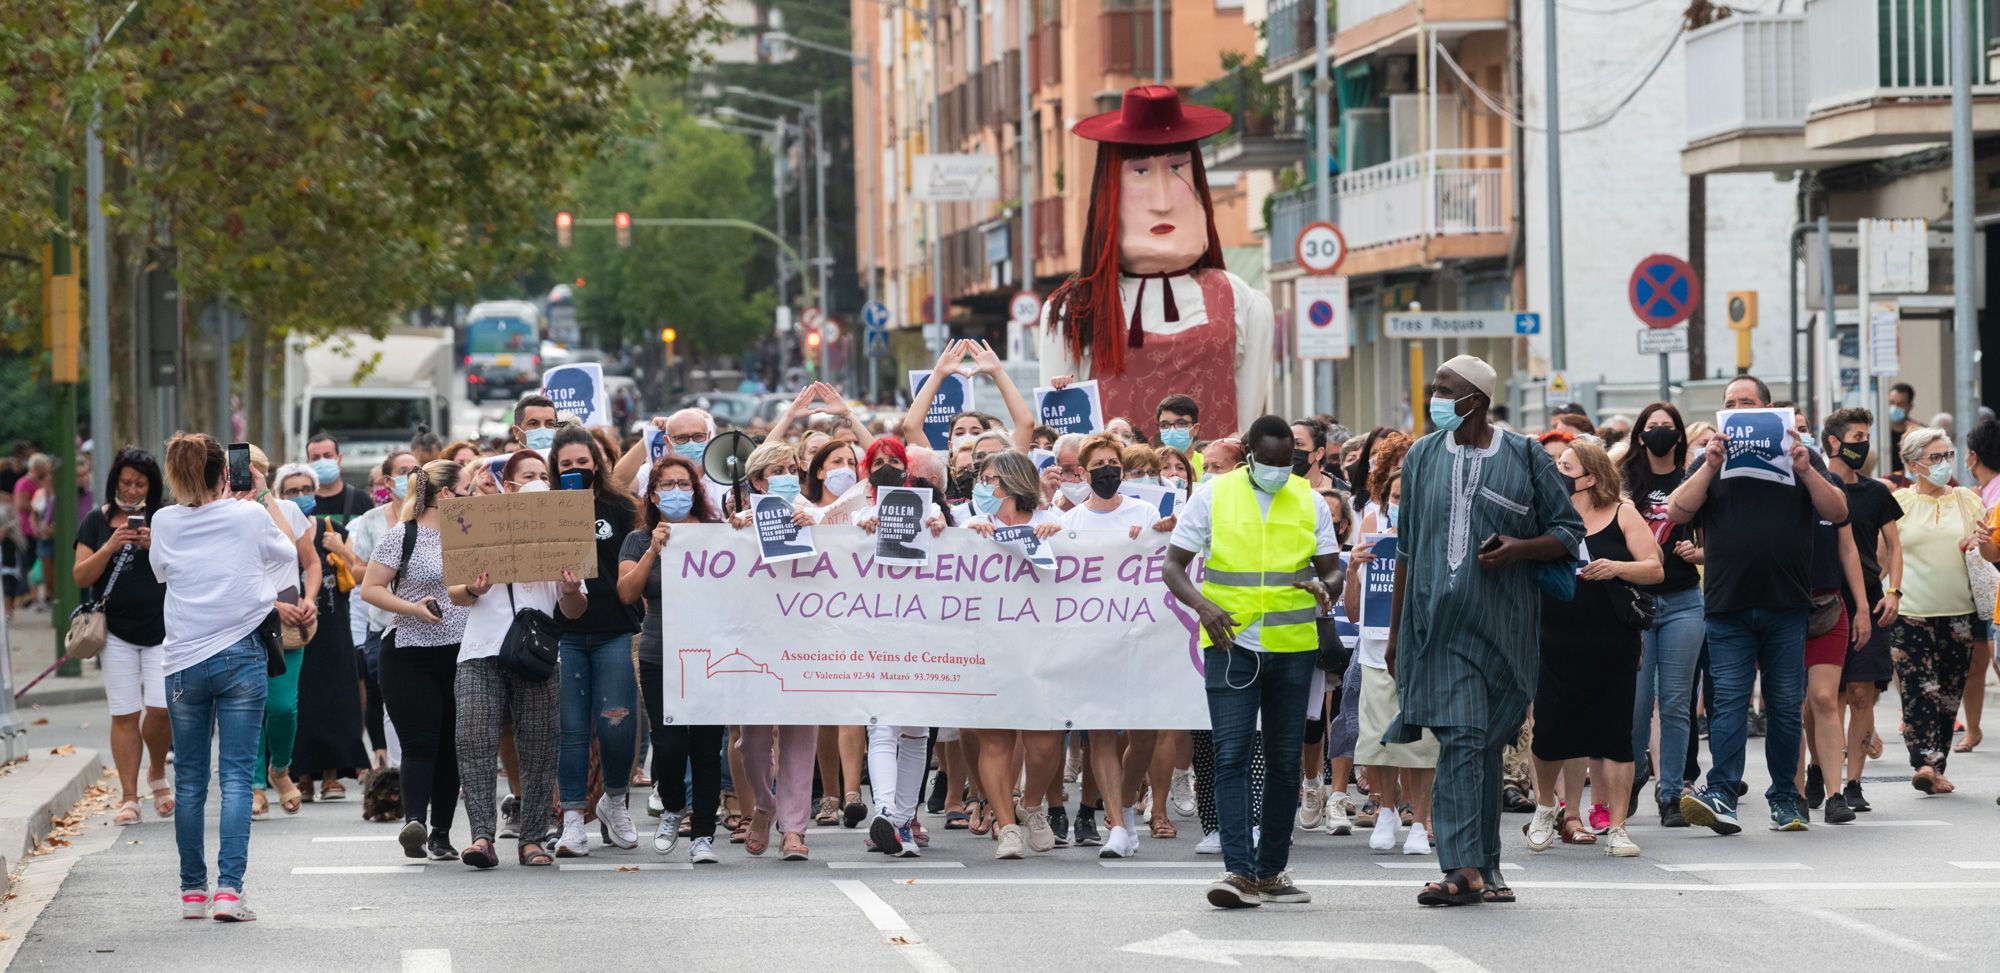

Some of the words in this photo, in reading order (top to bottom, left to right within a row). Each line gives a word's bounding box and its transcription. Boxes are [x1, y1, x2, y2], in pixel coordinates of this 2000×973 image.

[1305, 240, 1335, 257] 30
[1391, 318, 1423, 331] Tres
[1431, 317, 1485, 332] Roques
[546, 387, 576, 400] STOP
[554, 399, 586, 409] OLÈNCIA
[1042, 405, 1066, 418] CAP
[1045, 413, 1081, 426] AGRESSIÓ
[1725, 425, 1754, 438] CAP
[757, 508, 791, 520] VOLEM
[881, 505, 914, 516] VOLEM
[489, 519, 546, 533] TRABAJO
[995, 528, 1022, 541] STOP
[682, 550, 736, 578] NO
[748, 555, 776, 578] A
[791, 551, 838, 579] LA
[852, 551, 1041, 584] VIOLENCIA
[1055, 554, 1104, 584] DE
[1371, 558, 1395, 571] STO
[776, 592, 927, 620] VOCALIA
[940, 596, 982, 622] DE
[997, 597, 1040, 623] LA
[1055, 597, 1156, 624] DONA
[781, 649, 847, 661] Associació
[849, 650, 864, 661] de
[868, 650, 901, 662] Veïns
[904, 651, 918, 663] de
[921, 651, 986, 667] Cerdanyola
[815, 671, 851, 680] Valencia
[853, 671, 875, 680] 92-94
[879, 672, 910, 680] Mataró
